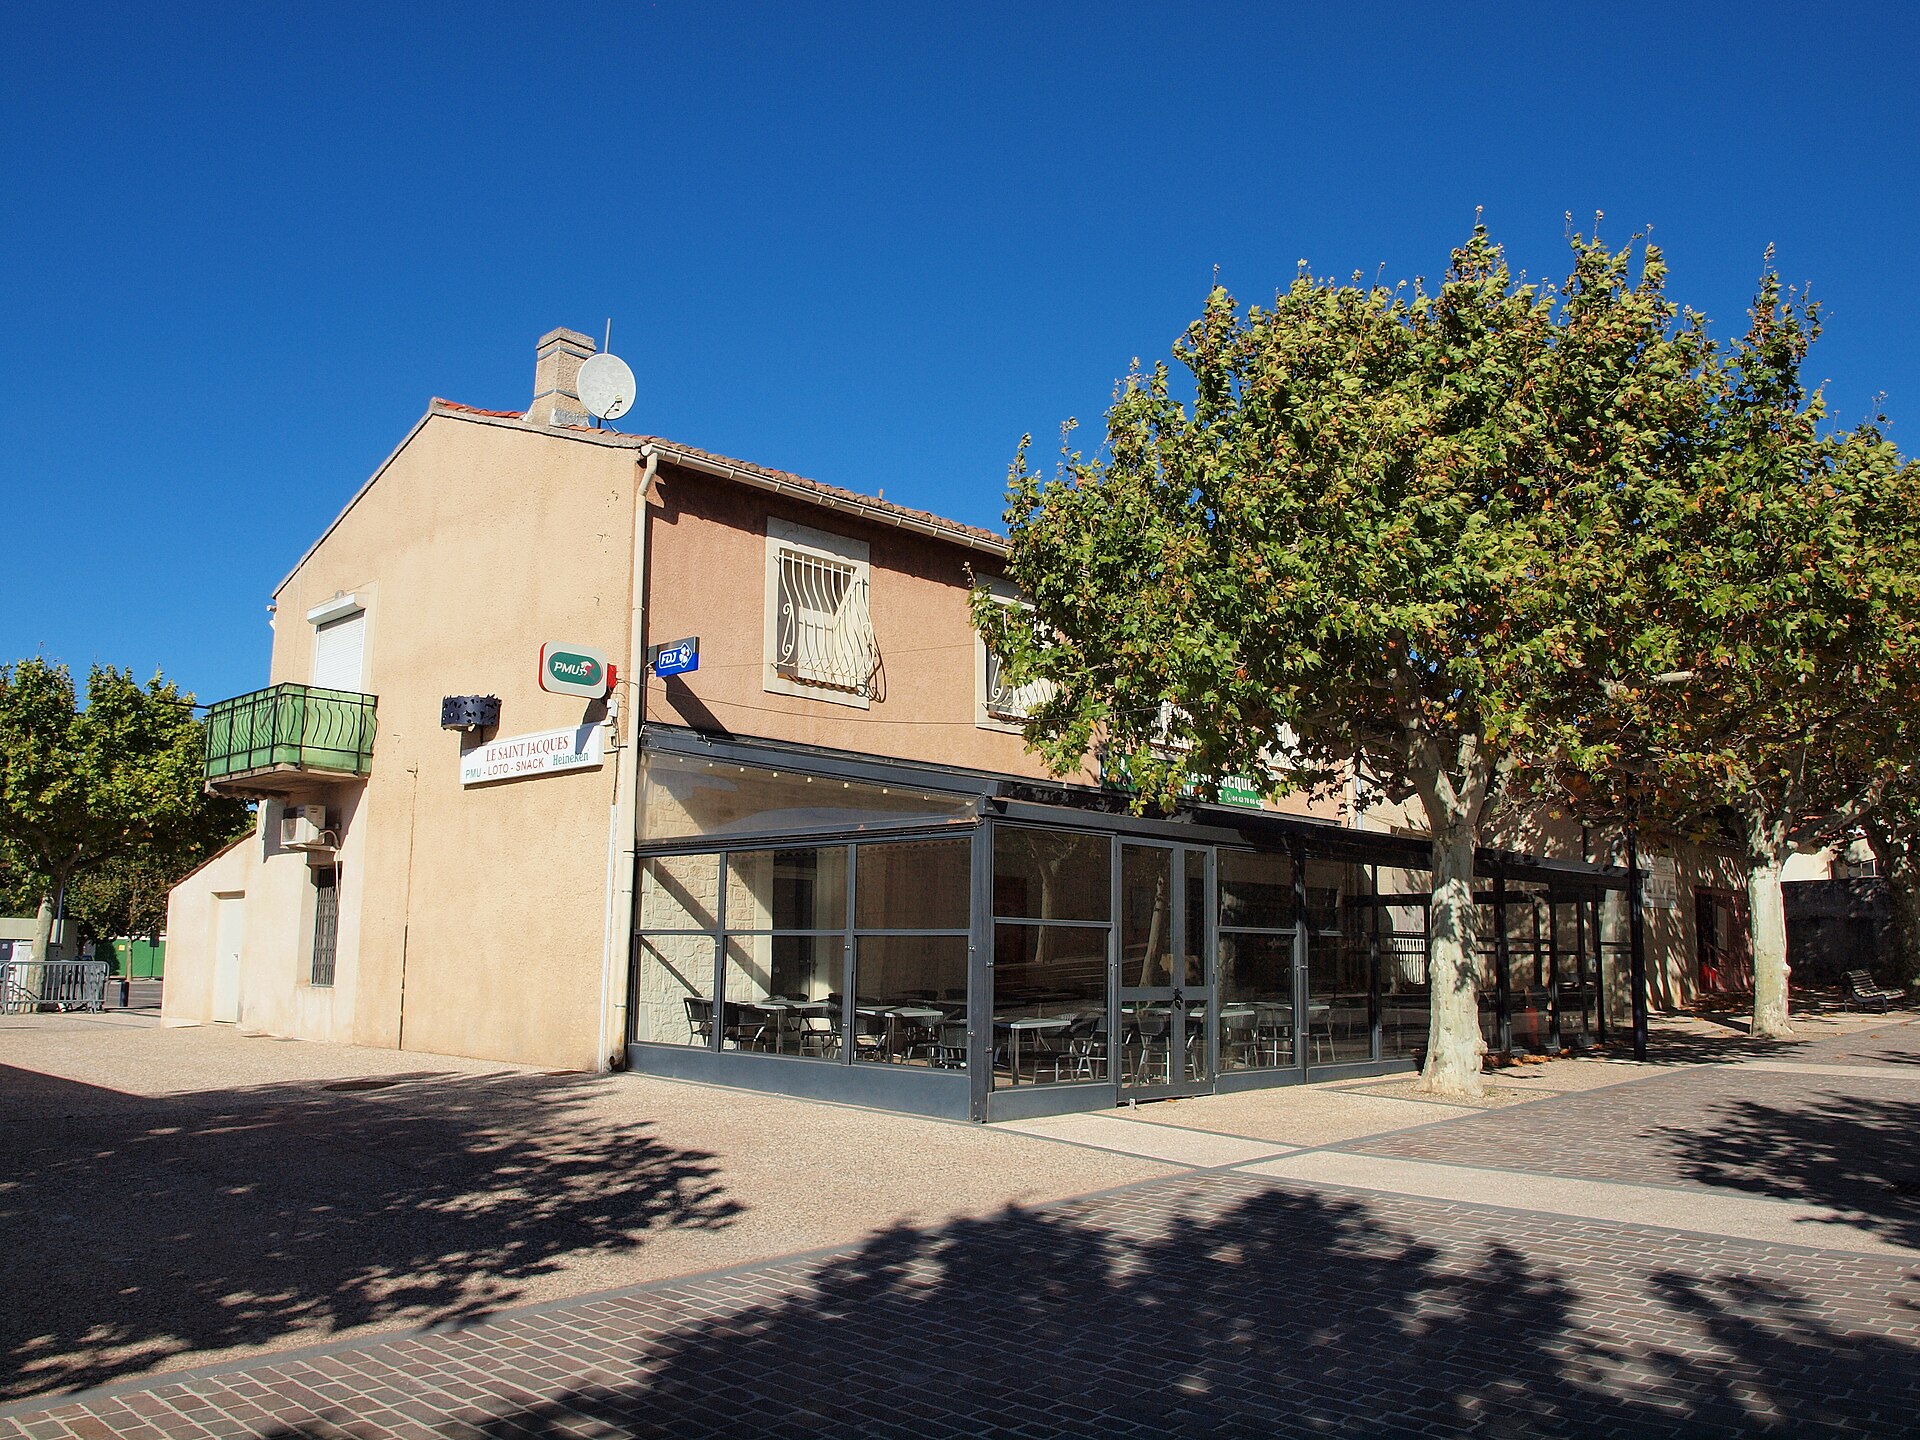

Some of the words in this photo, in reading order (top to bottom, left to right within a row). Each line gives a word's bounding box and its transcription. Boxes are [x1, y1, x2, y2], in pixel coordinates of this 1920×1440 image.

[661, 653, 677, 666] FDJ
[554, 661, 579, 676] PMU
[486, 749, 496, 762] LE
[498, 744, 526, 761] SAINT
[526, 736, 569, 758] JACQUES
[552, 752, 589, 766] Heineken
[466, 768, 482, 779] PMU
[488, 763, 509, 776] LOTO
[515, 758, 545, 772] SNACK
